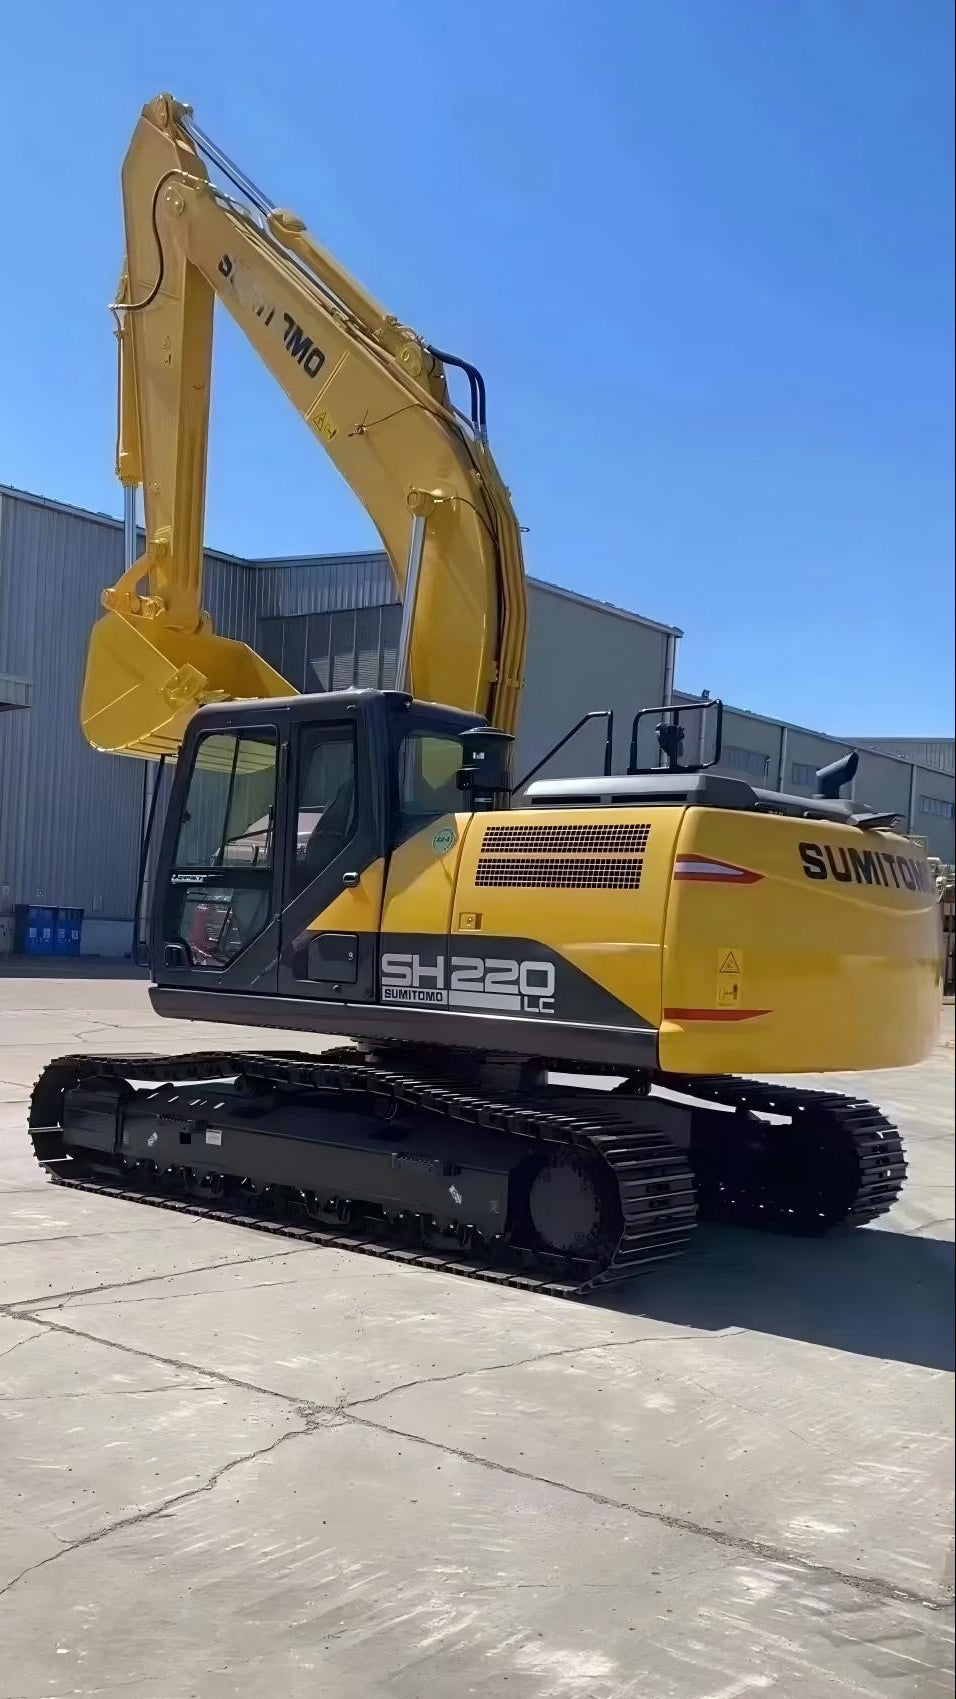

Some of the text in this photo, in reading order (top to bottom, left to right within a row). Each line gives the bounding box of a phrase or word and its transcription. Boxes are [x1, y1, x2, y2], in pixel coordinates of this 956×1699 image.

[798, 841, 930, 894] SUMITOM
[384, 988, 443, 1002] SUMITOMO
[524, 996, 555, 1014] LC
